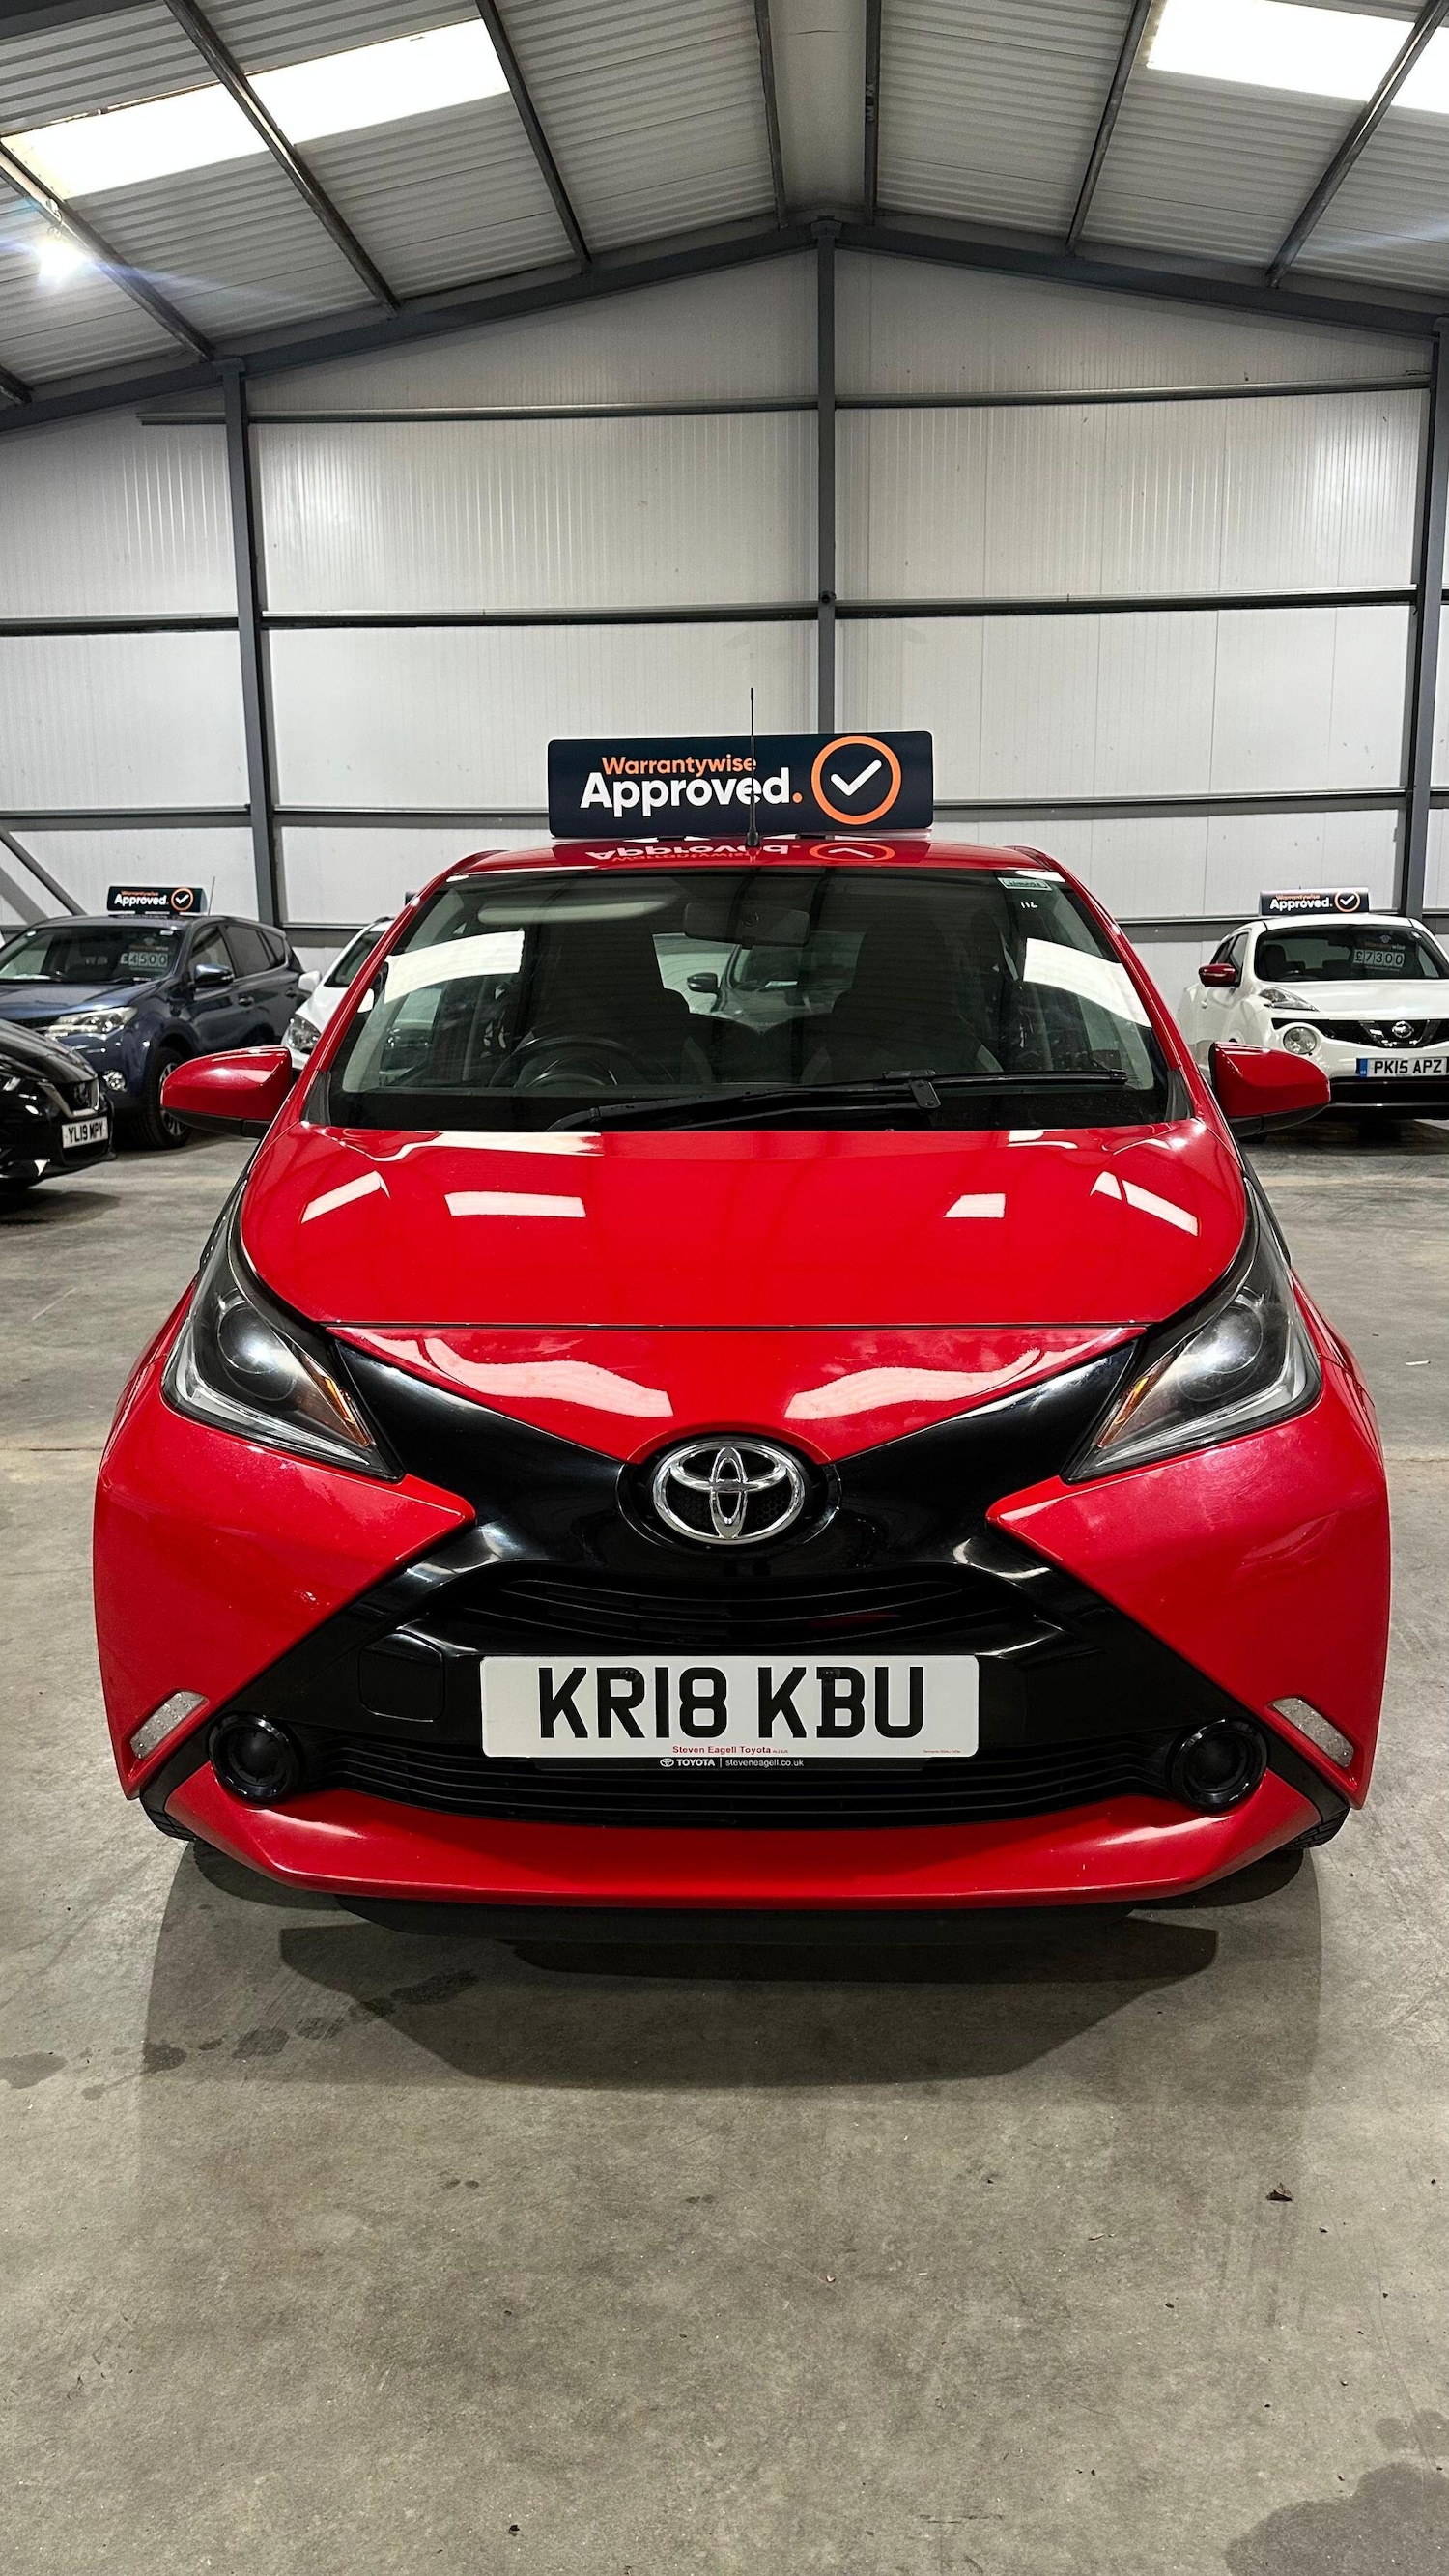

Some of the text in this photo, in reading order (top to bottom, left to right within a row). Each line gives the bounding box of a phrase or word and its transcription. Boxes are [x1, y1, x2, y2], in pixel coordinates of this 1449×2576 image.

[602, 755, 756, 778] Warrantywise
[580, 767, 803, 817] Approved.
[1270, 897, 1333, 911] Approved.
[1354, 950, 1404, 965] £7300
[1374, 1060, 1408, 1074] PK15
[1413, 1059, 1442, 1073] APZ
[68, 1124, 88, 1144] YL19
[538, 1666, 924, 1738] KR18 KBU
[672, 1745, 705, 1754] Steven
[707, 1745, 737, 1755] Eagell
[739, 1745, 772, 1755] Toyota
[676, 1759, 805, 1768] TOYOTA steveneagell.co.uk
